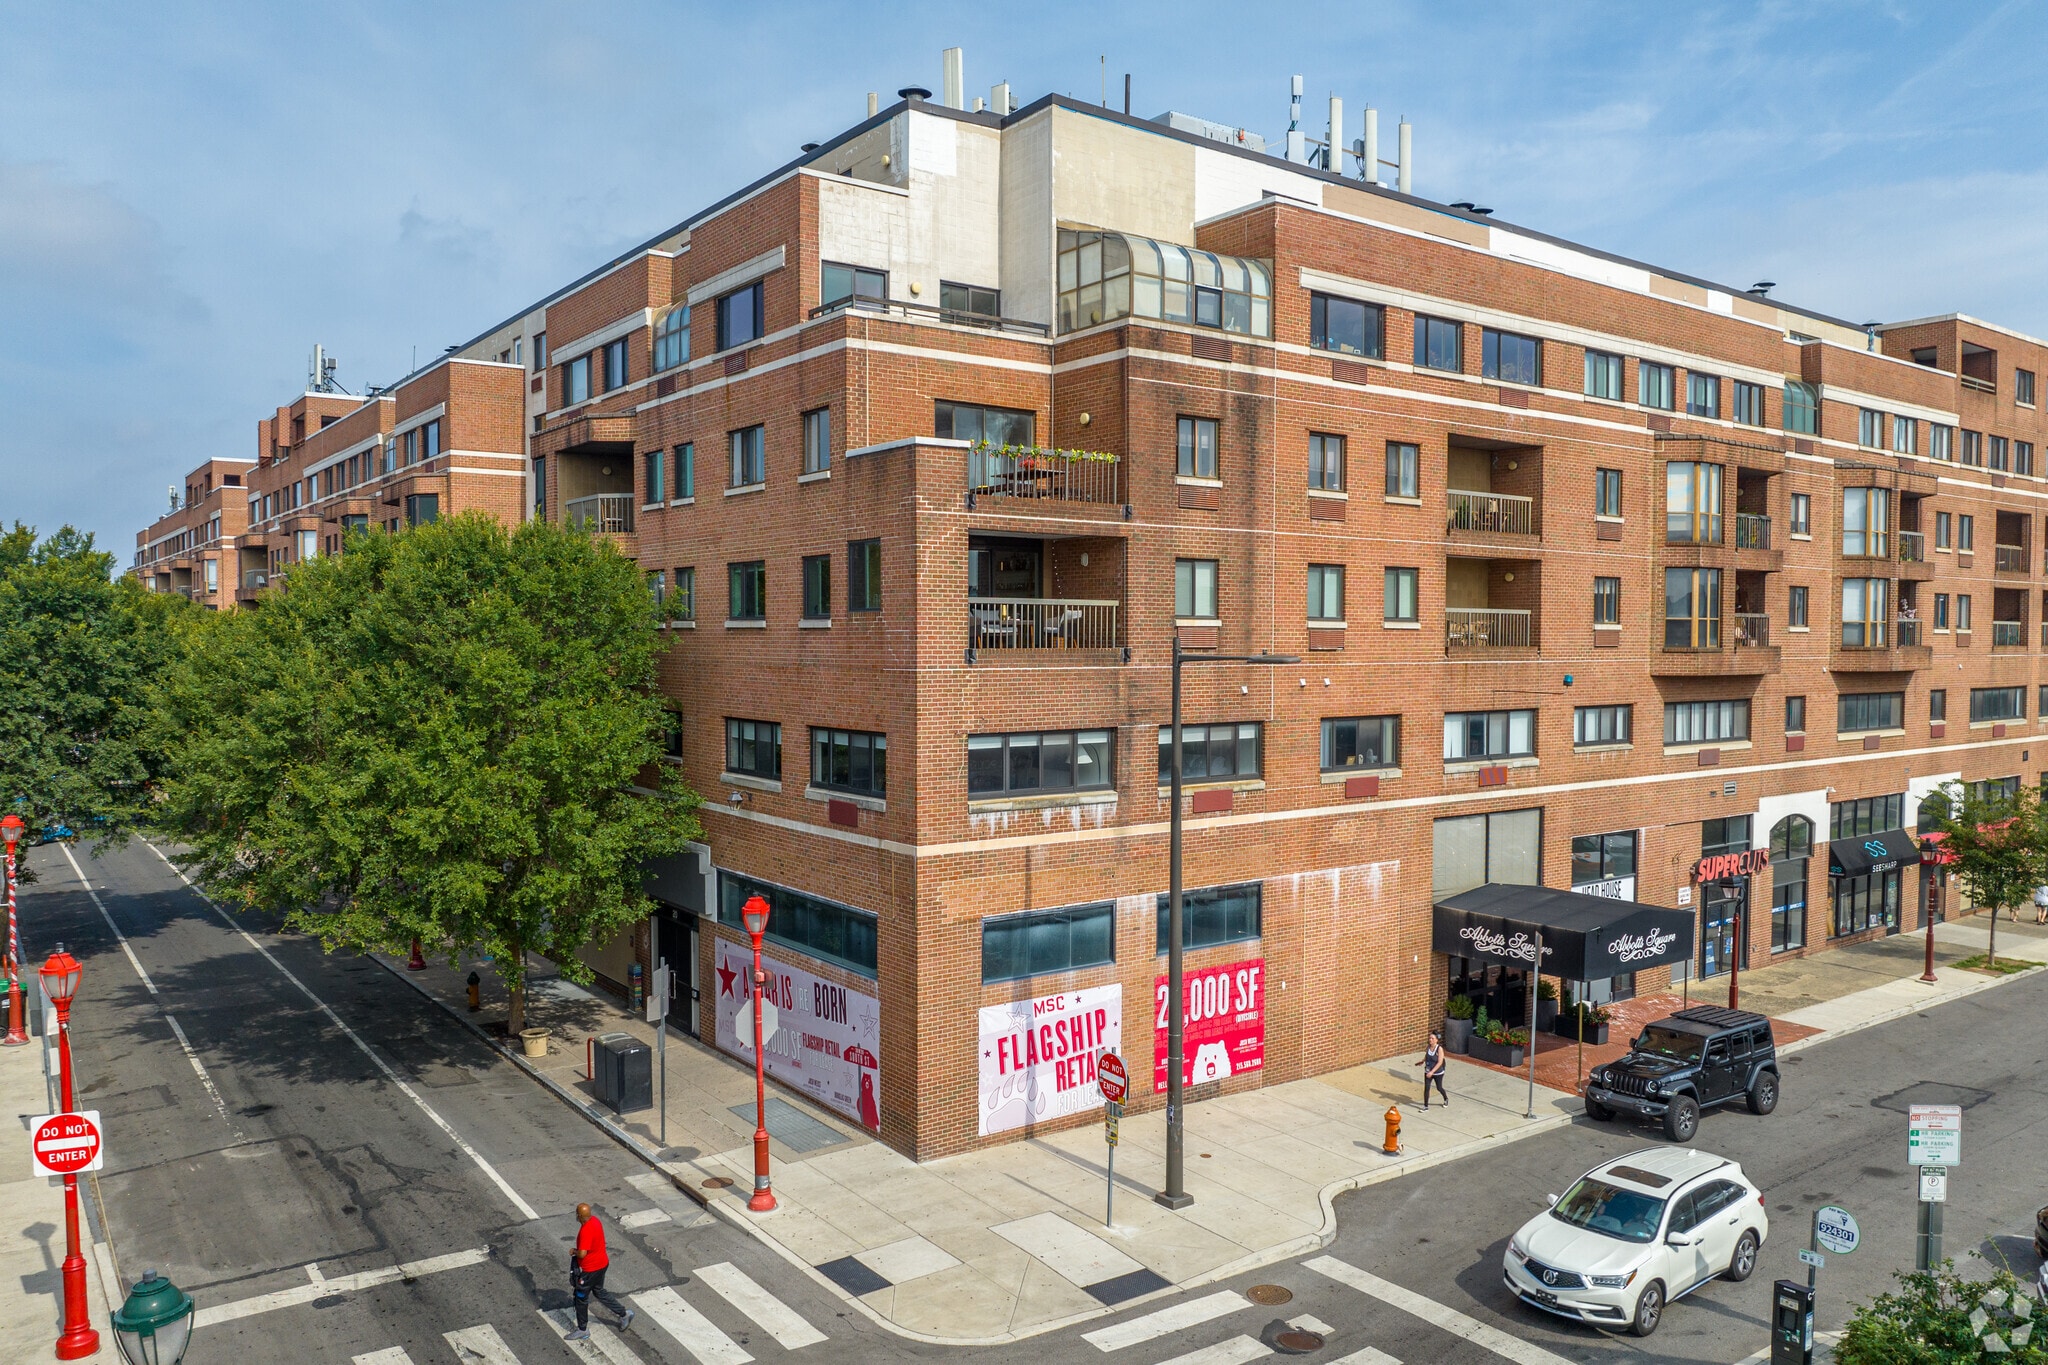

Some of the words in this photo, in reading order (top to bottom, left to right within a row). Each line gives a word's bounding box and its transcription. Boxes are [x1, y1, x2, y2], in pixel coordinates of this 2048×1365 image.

[1697, 848, 1770, 882] SUPERCUTS
[1872, 860, 1898, 872] SEESHARP
[1601, 881, 1621, 899] HOUSE
[1459, 925, 1505, 946] Abbotts
[1508, 932, 1553, 957] Squre
[1608, 934, 1643, 954] Abbotts
[1646, 928, 1676, 948] Square
[743, 966, 750, 999] A
[780, 974, 793, 1011] IS
[814, 982, 848, 1025] BORN
[1034, 996, 1065, 1018] MSC
[1157, 972, 1230, 1028] 2,000
[1234, 966, 1260, 1012] SF
[791, 1030, 802, 1061] SF
[802, 1032, 824, 1052] FLAGSHIP
[825, 1038, 841, 1058] RETAIL
[997, 1008, 1107, 1076] FLAGSHIP
[1055, 1048, 1103, 1093] RETA
[1102, 1059, 1110, 1069] DO
[1112, 1062, 1122, 1076] NOT
[1057, 1089, 1078, 1115] FOR
[1081, 1084, 1104, 1109] LEA
[1103, 1081, 1120, 1095] ENTER
[42, 1128, 58, 1138] DO
[66, 1124, 88, 1135] NOT
[48, 1150, 86, 1163] ENTER
[1820, 1223, 1853, 1242] 924301
